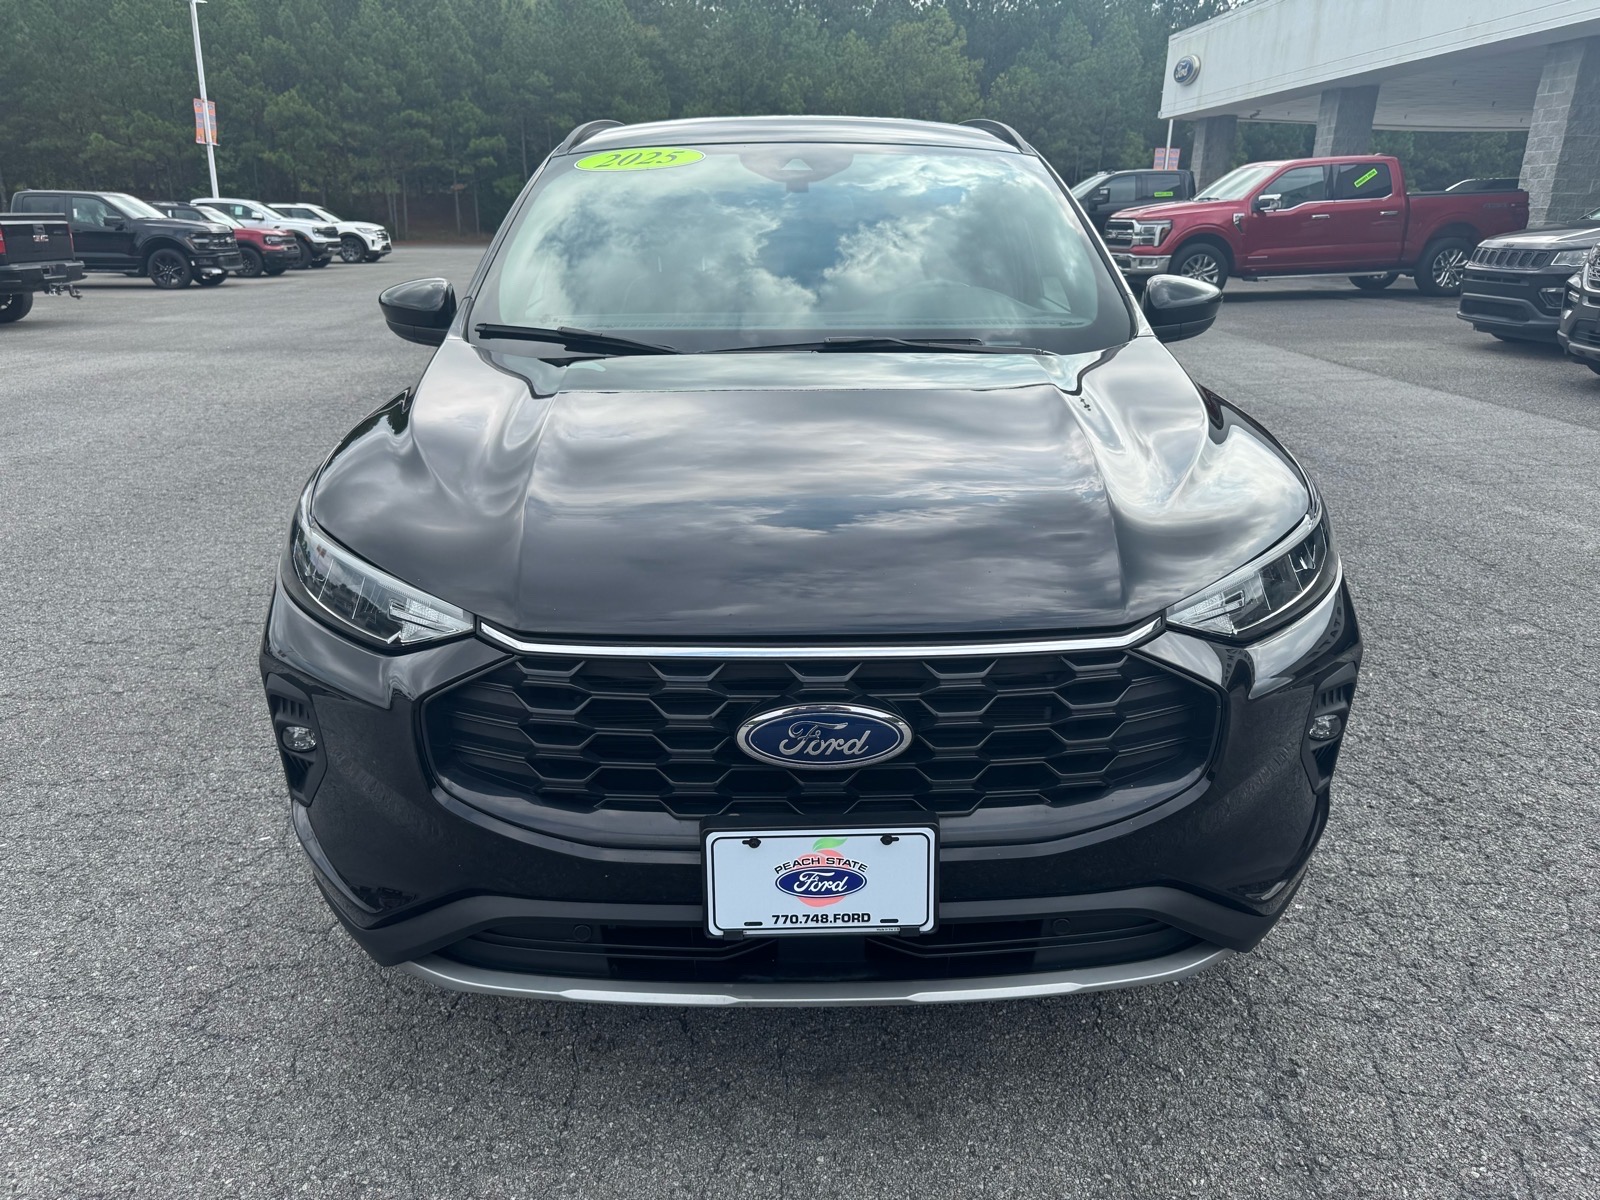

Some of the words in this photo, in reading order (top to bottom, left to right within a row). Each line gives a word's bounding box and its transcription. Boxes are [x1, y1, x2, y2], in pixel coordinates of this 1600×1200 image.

[593, 151, 685, 168] 2025
[779, 720, 872, 756] Ford
[774, 857, 820, 874] PEACH
[826, 857, 868, 873] STATE
[793, 871, 849, 892] Ford
[771, 912, 871, 925] 770.748.FORD
